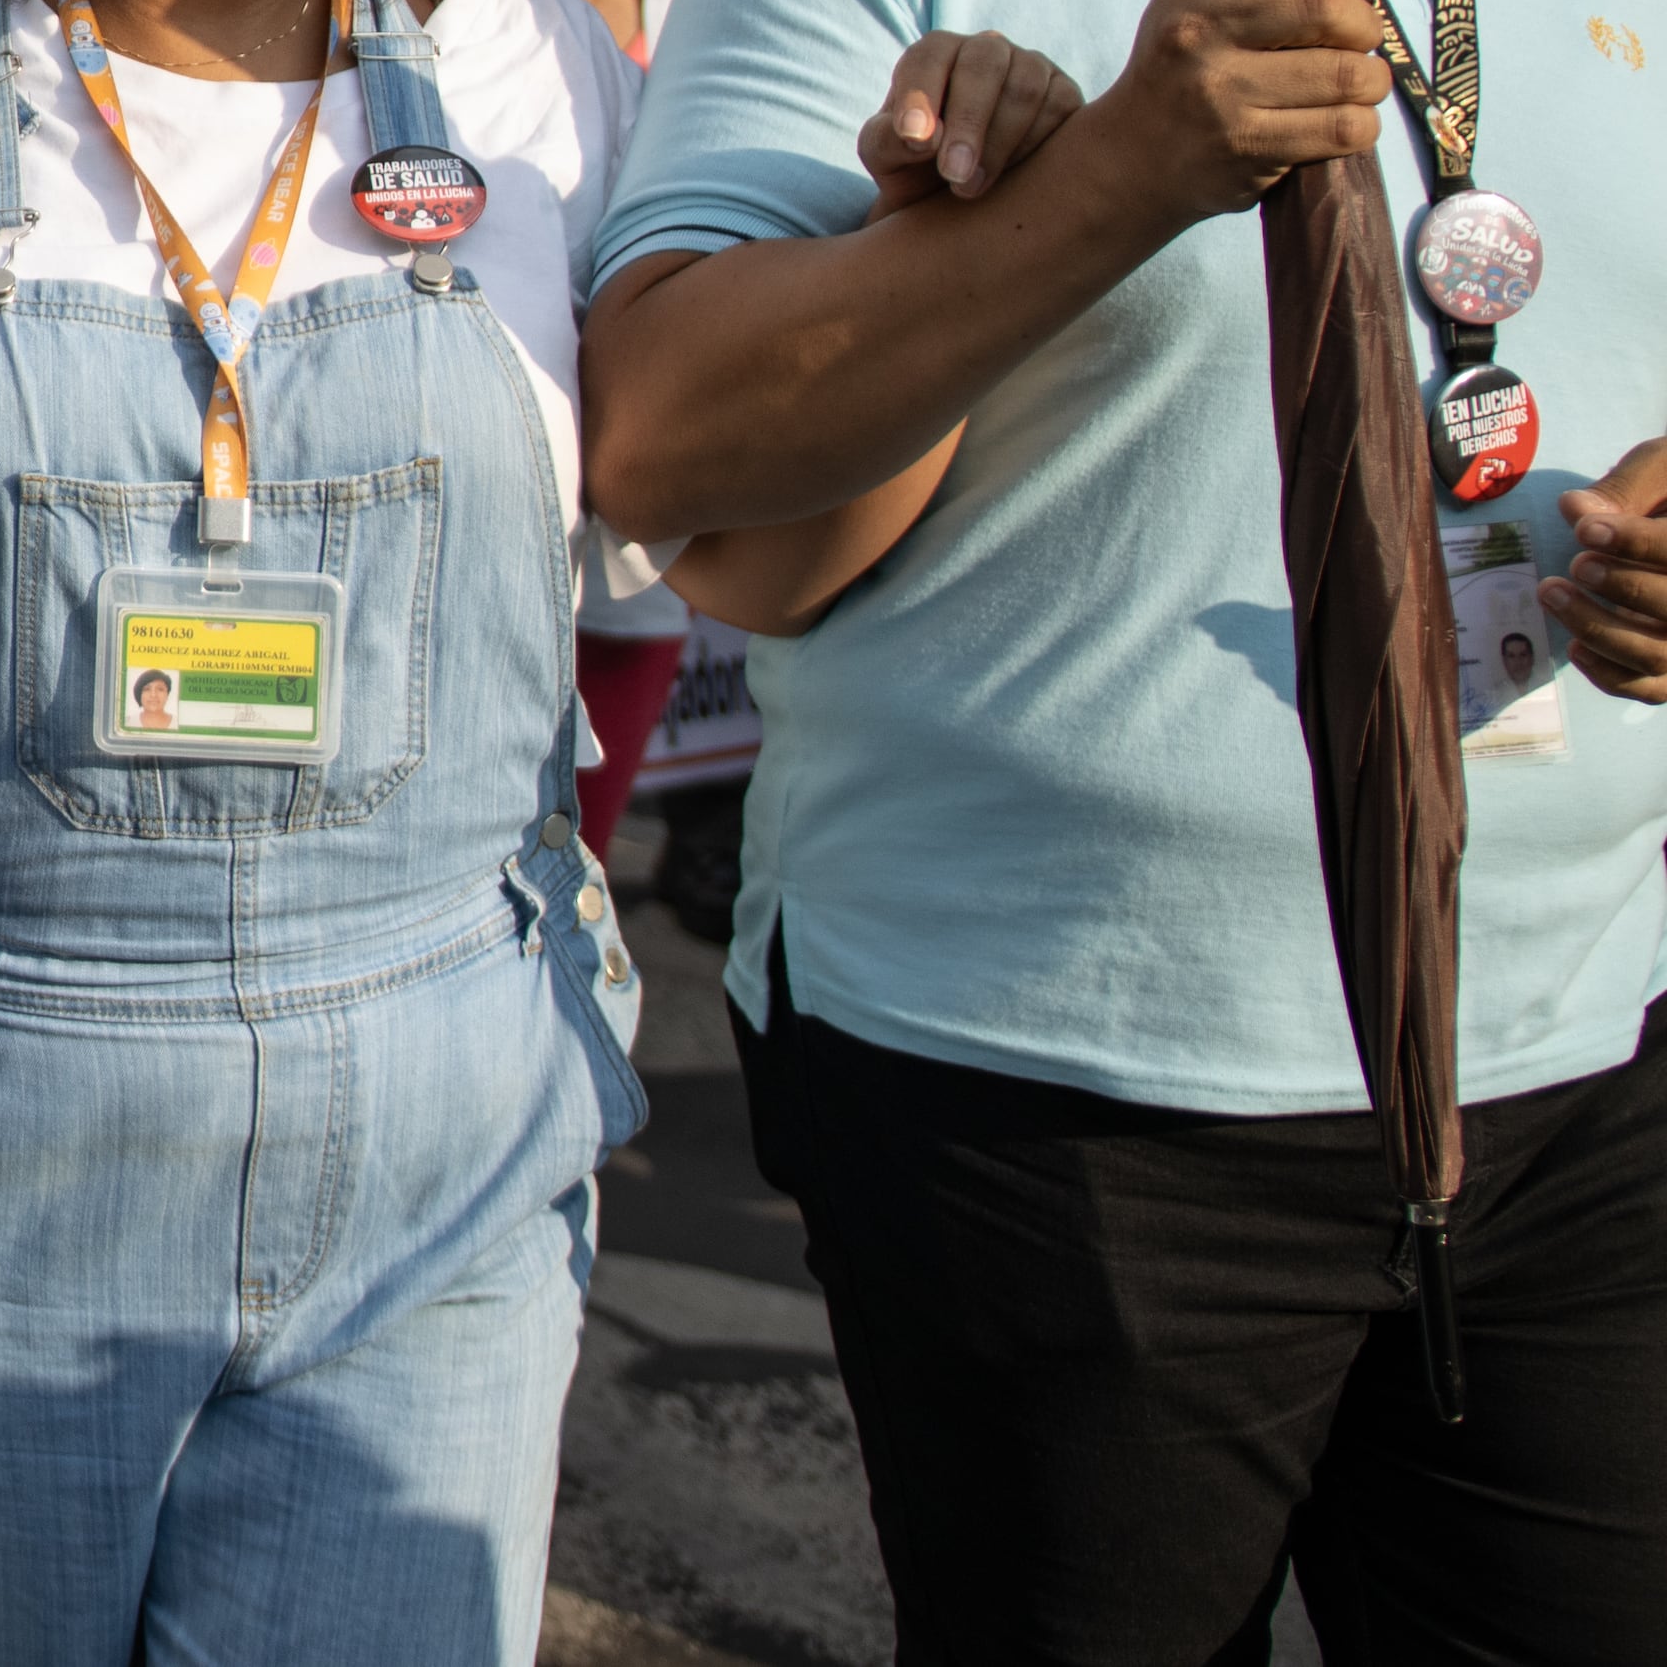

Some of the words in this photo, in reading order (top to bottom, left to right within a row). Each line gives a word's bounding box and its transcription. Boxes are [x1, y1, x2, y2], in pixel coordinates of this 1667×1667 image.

[367, 158, 463, 175] TRABAJADORES
[370, 173, 398, 191] DE
[400, 169, 465, 188] SALUD
[266, 176, 293, 223] BEAR
[364, 191, 405, 204] UNIDOS
[406, 189, 421, 201] EN
[424, 188, 437, 200] LA
[439, 187, 475, 199] LUCHA
[1450, 216, 1535, 263] SALUD
[1442, 398, 1471, 425] ¡EN
[1471, 383, 1528, 419] LUCHA!
[1447, 420, 1473, 442] POR
[1472, 407, 1529, 436] NUESTROS
[1460, 428, 1518, 456] DERECHOS
[211, 441, 234, 498] SPAC
[131, 625, 195, 640] 98161630
[130, 645, 190, 656] LORENCEZ
[192, 648, 242, 659] RAMIREZ
[243, 650, 290, 661] ABIGAIL
